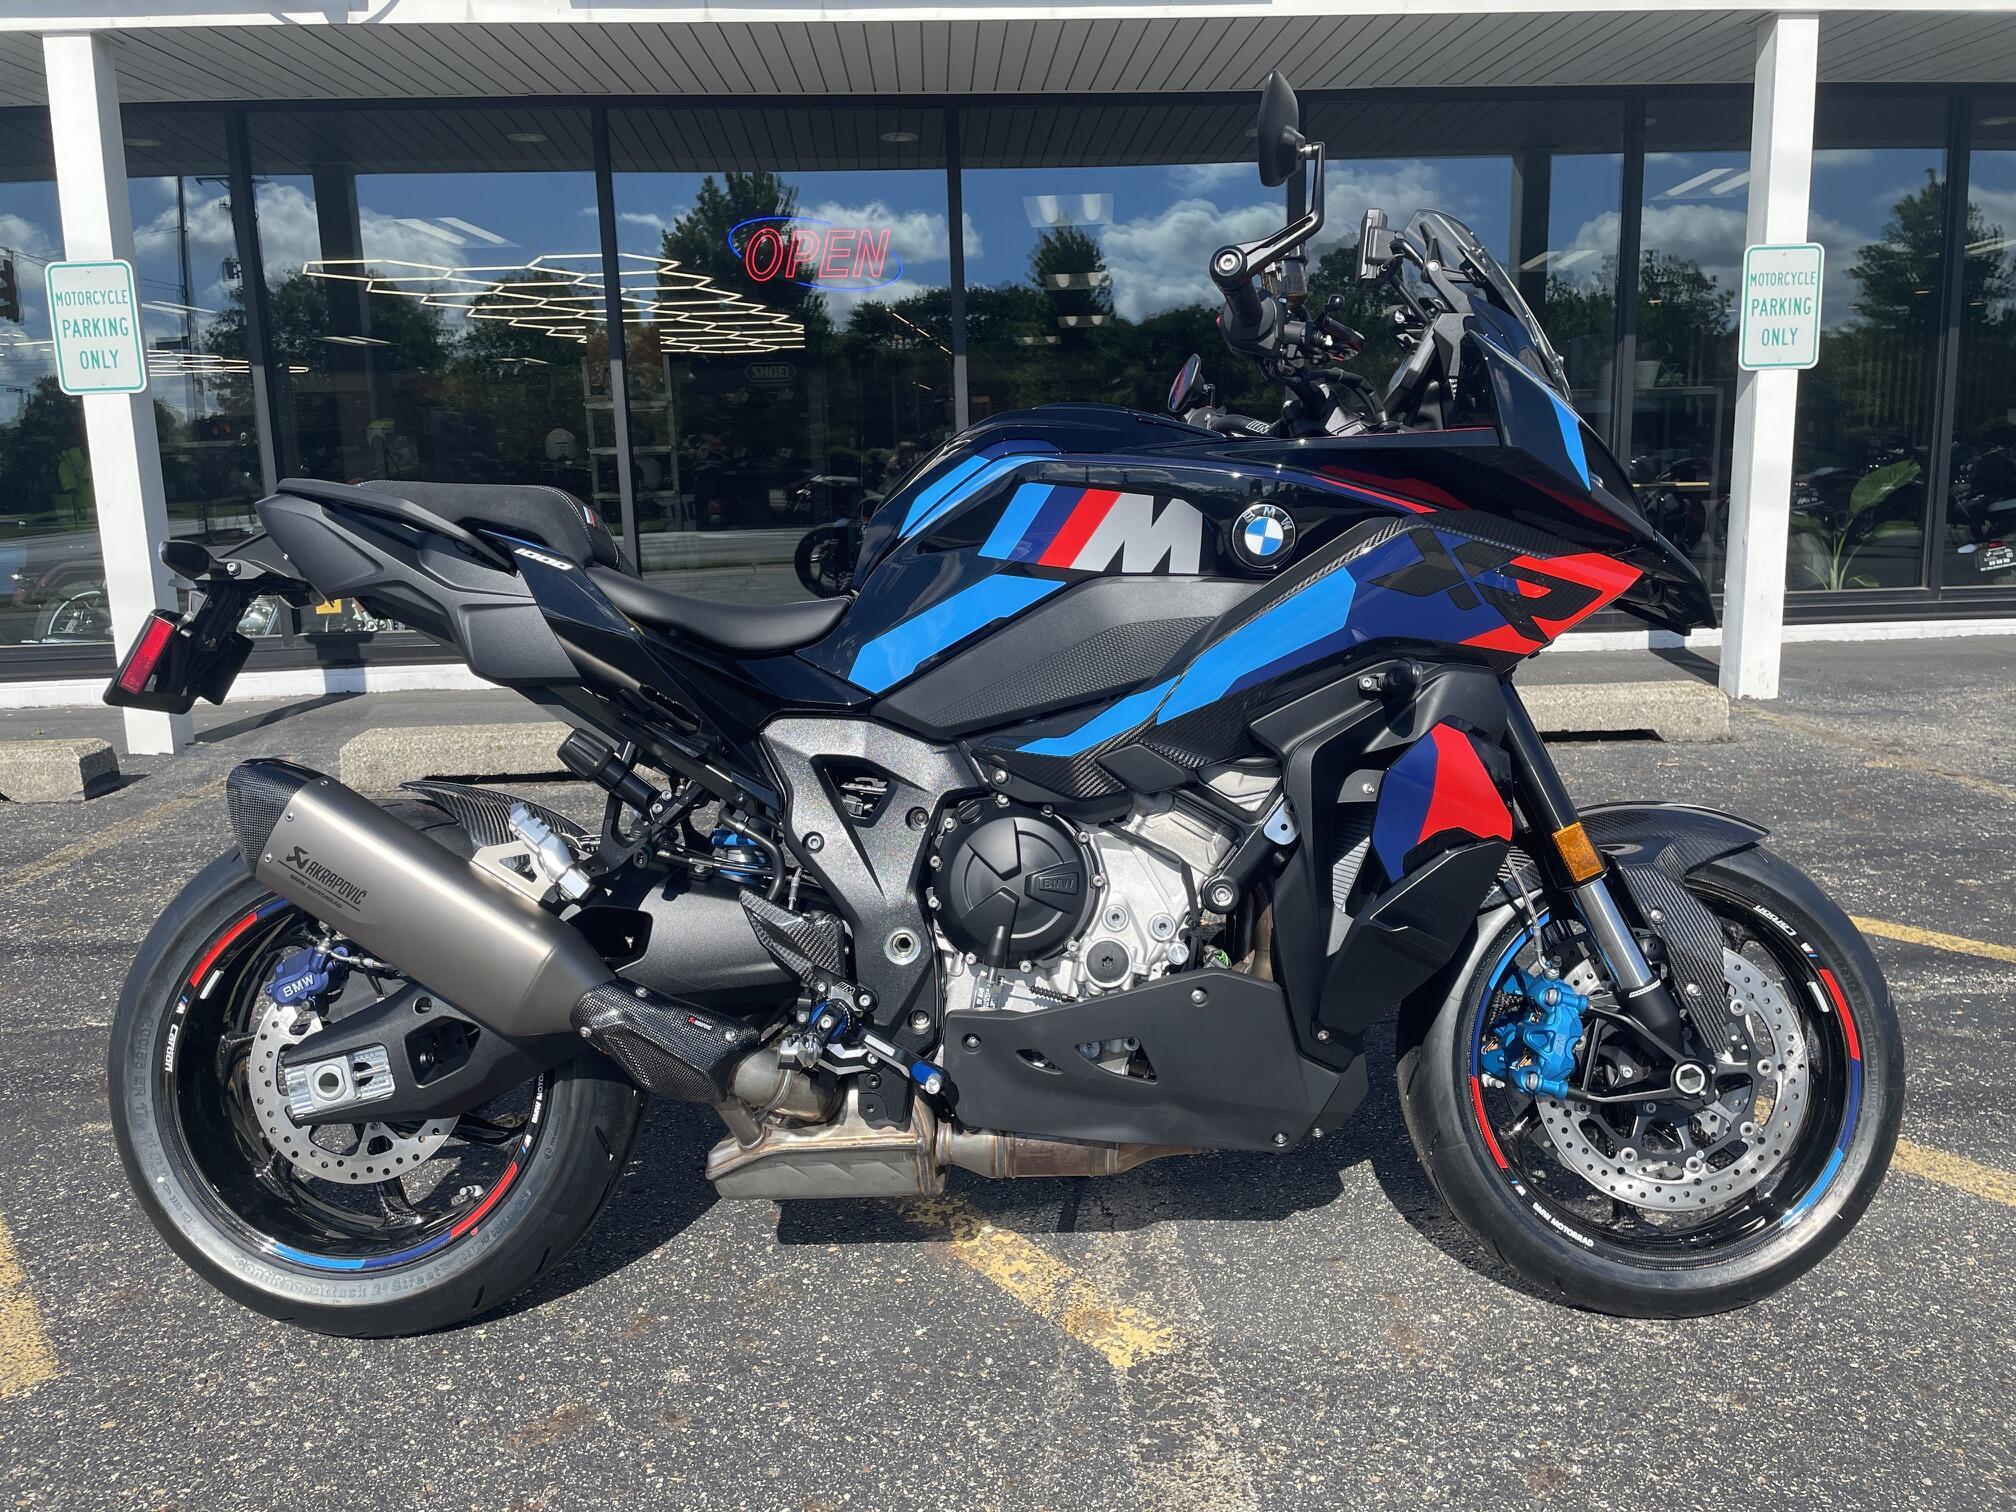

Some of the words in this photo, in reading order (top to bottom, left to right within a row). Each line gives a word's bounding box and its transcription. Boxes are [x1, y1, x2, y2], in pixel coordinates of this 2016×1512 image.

[745, 228, 890, 282] OPEN
[1750, 271, 1817, 287] MOTORCYCLE
[55, 289, 129, 307] MOTORCYCLE
[1751, 297, 1812, 316] PARKING
[62, 317, 129, 338] PARKING
[1761, 327, 1799, 346] ONLY
[79, 349, 119, 370] ONLY
[751, 365, 790, 380] SHOEI
[1243, 505, 1294, 531] BMW
[1069, 492, 1203, 574] M
[514, 547, 573, 571] 1000
[289, 874, 307, 887] BMW
[307, 884, 343, 909] MOTORRAD
[1044, 879, 1074, 889] BMW
[282, 974, 315, 998] BMW
[536, 1073, 544, 1101] MOTO
[1532, 1201, 1552, 1221] BMW
[1551, 1217, 1595, 1247] MOTORRAD
